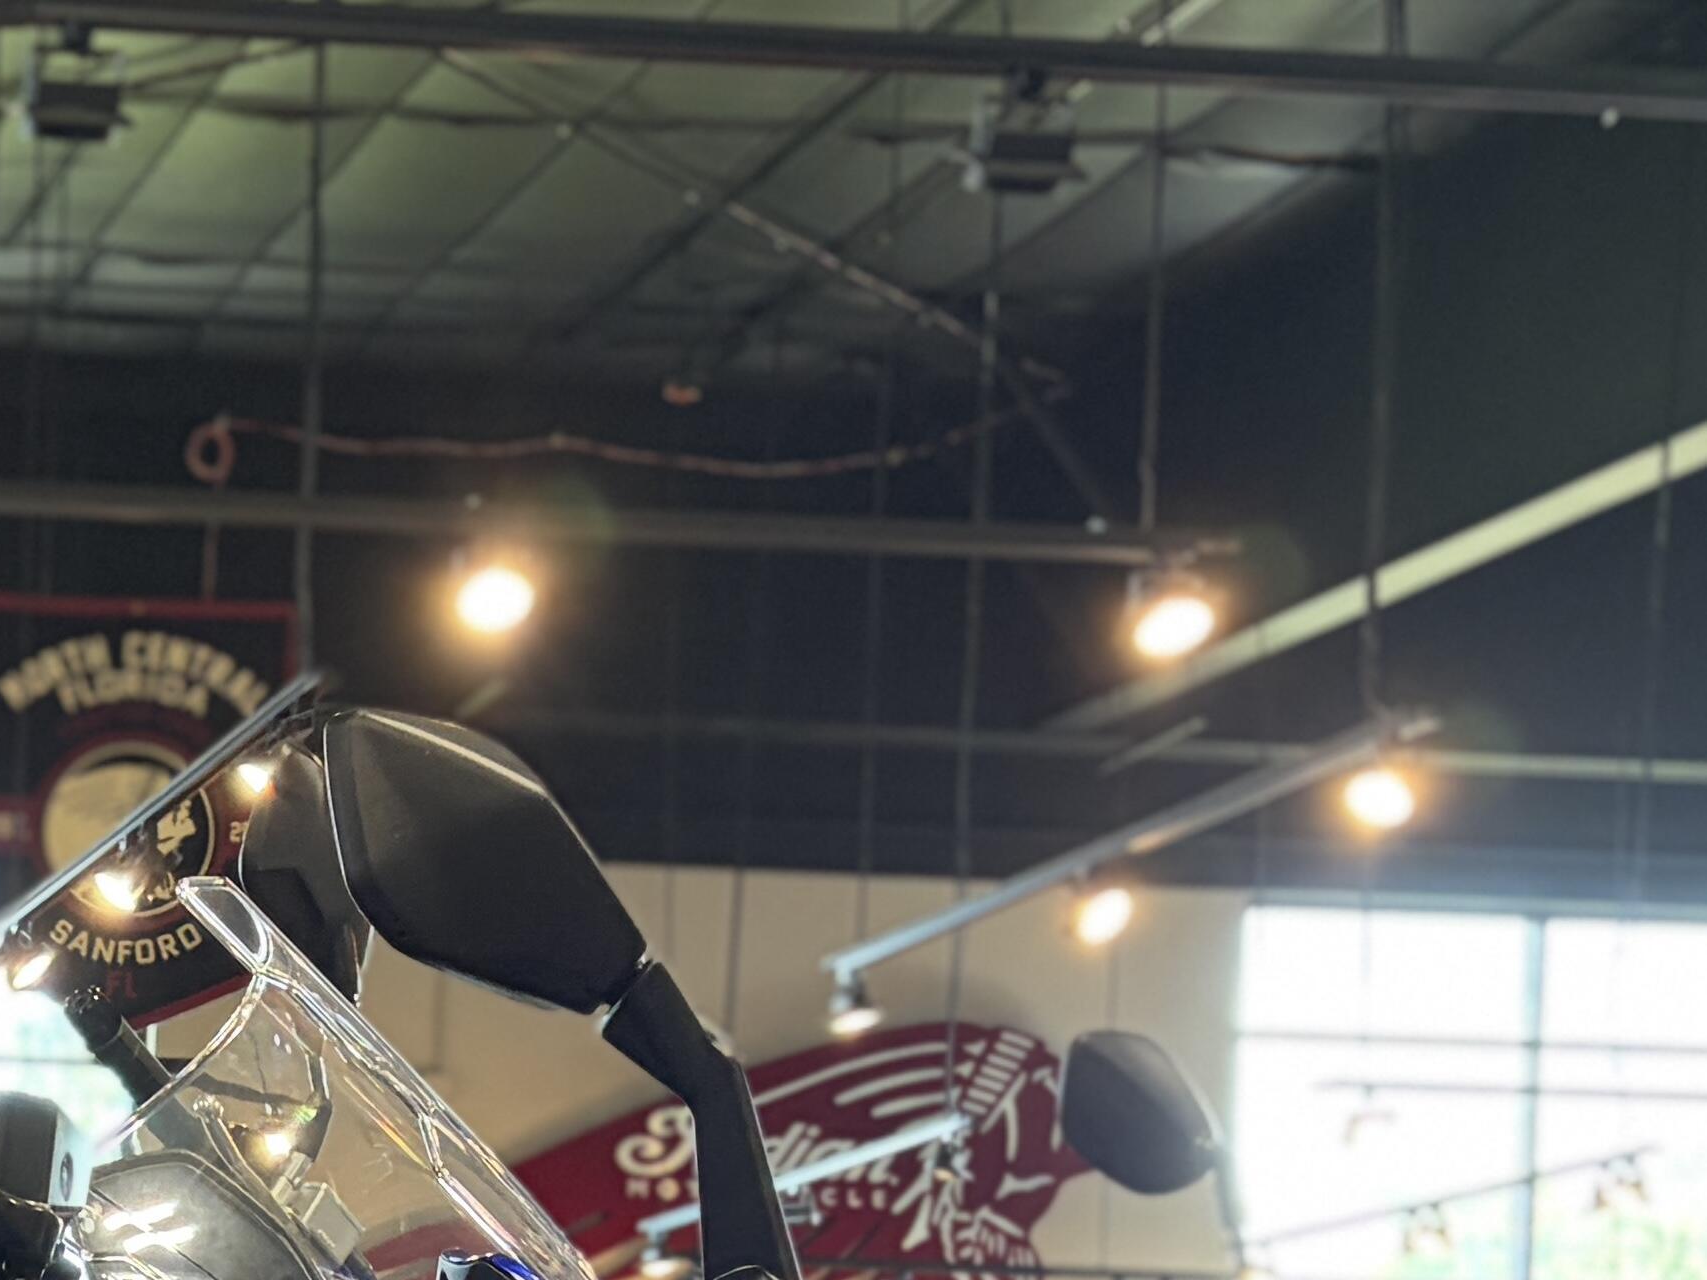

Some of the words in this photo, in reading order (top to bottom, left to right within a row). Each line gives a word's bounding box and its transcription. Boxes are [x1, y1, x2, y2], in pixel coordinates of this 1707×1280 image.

[57, 669, 209, 718] FLORIDA
[121, 631, 271, 717] CENTRAL
[49, 919, 203, 966] SANFORD
